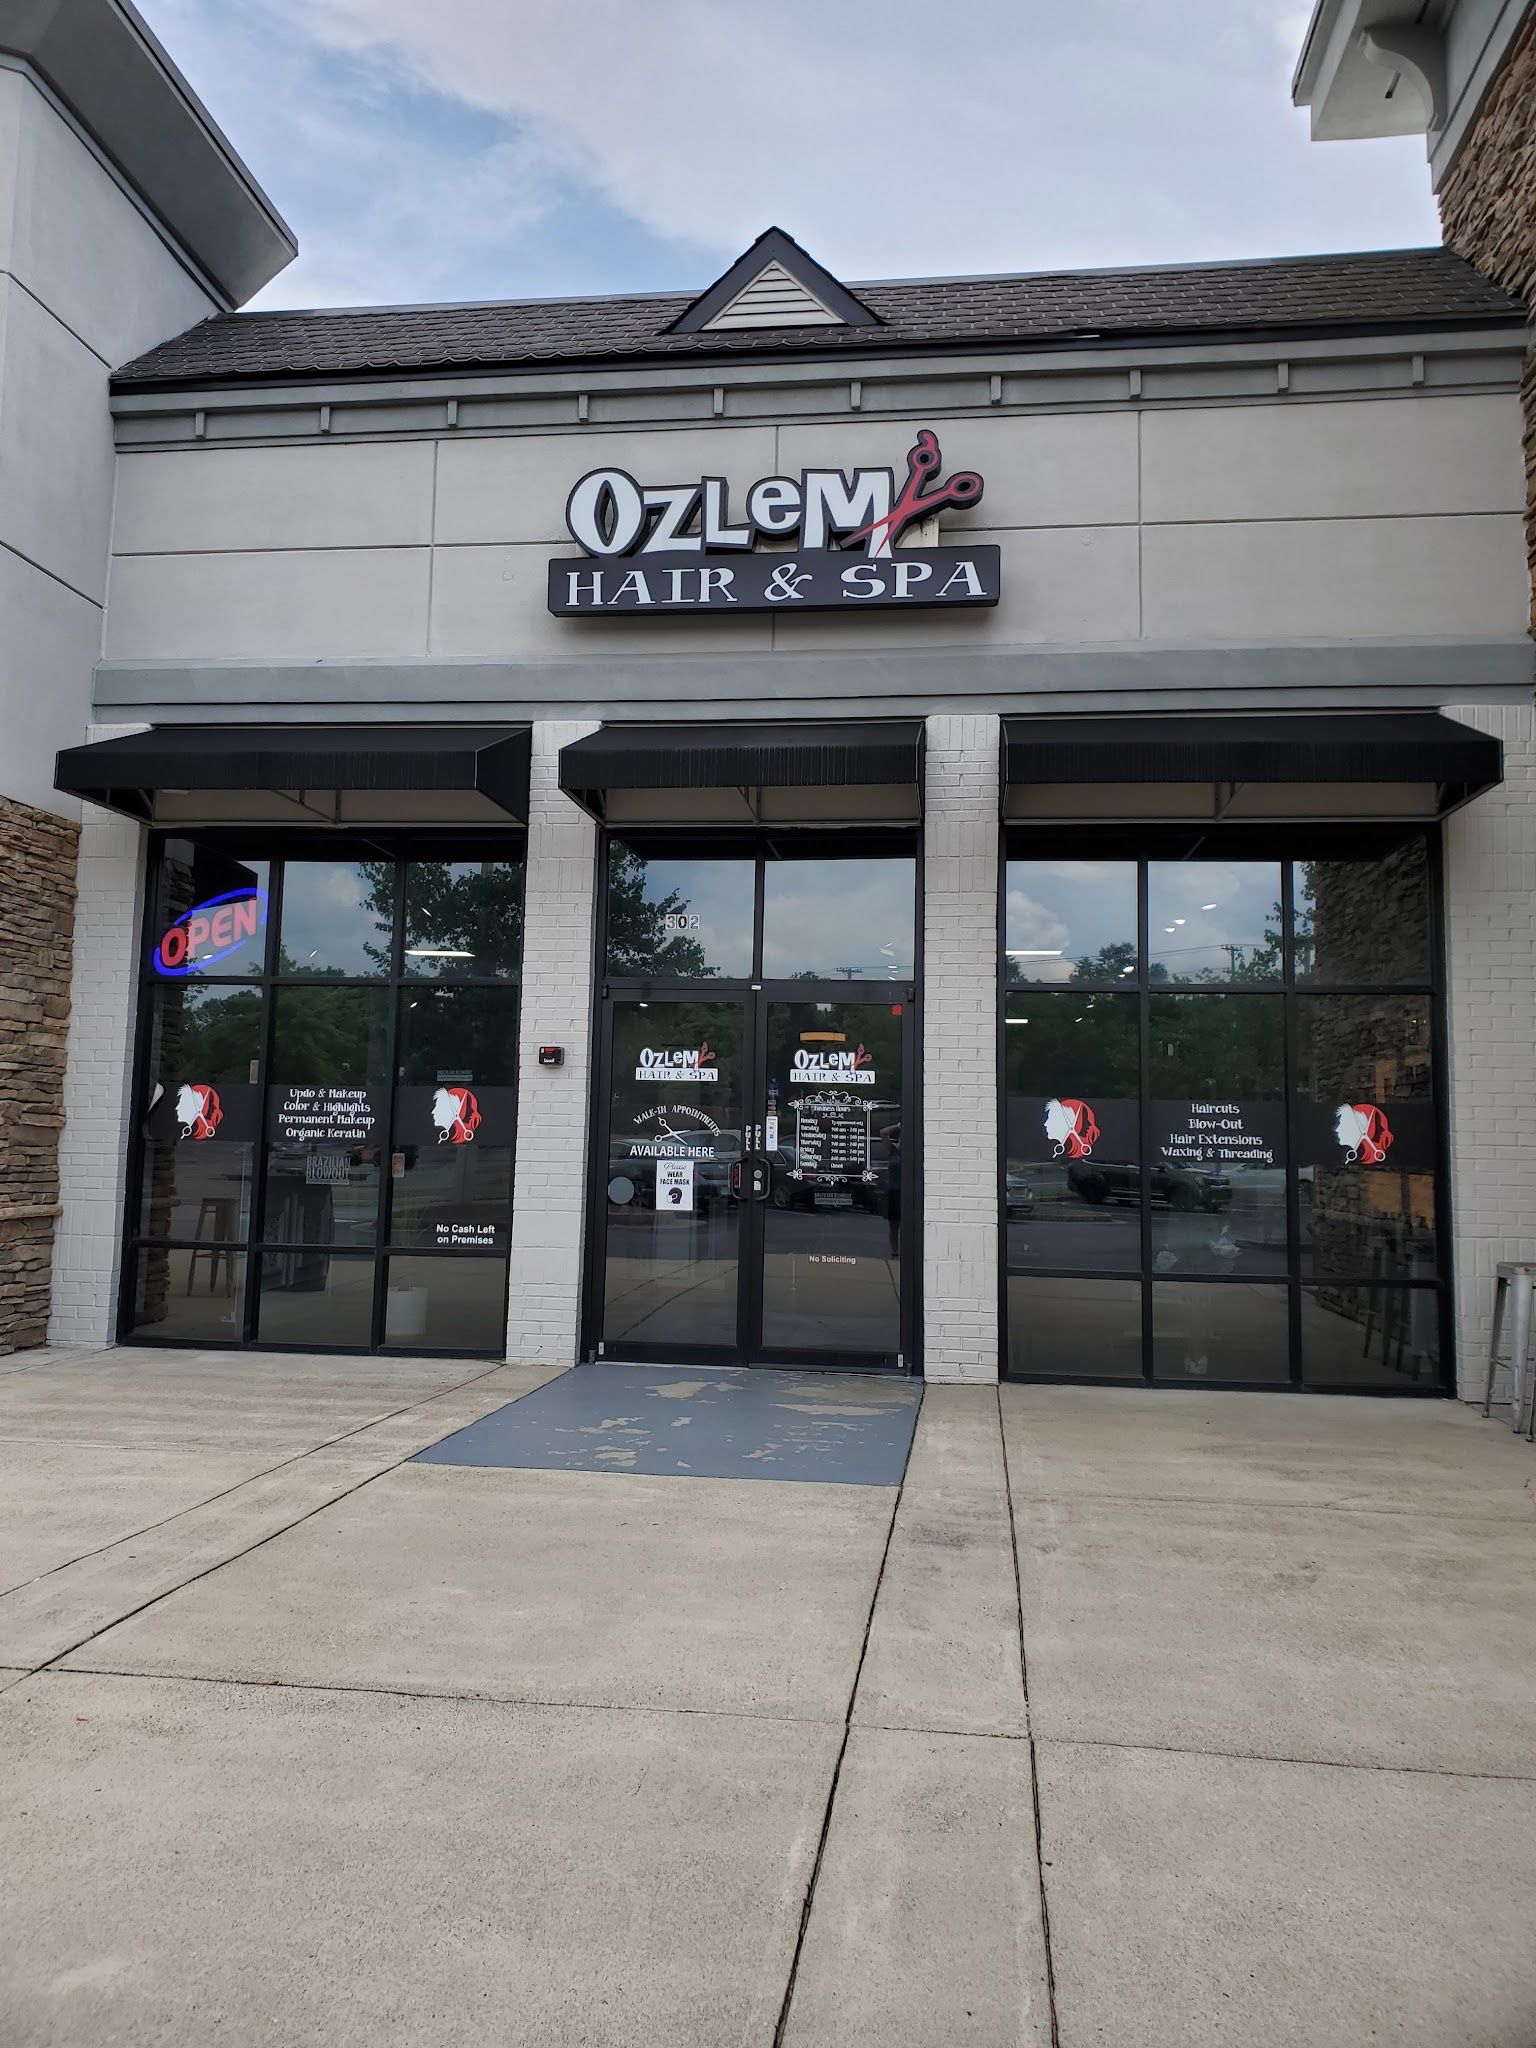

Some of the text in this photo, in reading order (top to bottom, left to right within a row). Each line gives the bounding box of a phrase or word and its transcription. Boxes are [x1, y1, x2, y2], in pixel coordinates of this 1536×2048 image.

[565, 561, 988, 606] HAIR & SPA
[666, 914, 700, 930] 302
[161, 897, 257, 967] OPEN
[639, 1070, 715, 1080] HAIR & SPA
[794, 1073, 872, 1083] HAIR & SPA
[290, 1088, 367, 1104] Updo & Makeup
[284, 1101, 371, 1116] Color & Highlights
[1191, 1103, 1241, 1114] Haircuts
[278, 1113, 375, 1130] Permanent Makeup
[633, 1104, 721, 1137] WALK-IN APPOINTMENTS
[1187, 1118, 1245, 1129] Blow-Out
[285, 1127, 366, 1141] Organic Keratin
[1169, 1133, 1263, 1145] Hair Extensions
[629, 1145, 715, 1157] AVAILABLE HERE
[1160, 1146, 1274, 1163] Waxing & Threading
[306, 1156, 351, 1168] BRAZILIAN
[663, 1161, 687, 1170] Please
[306, 1167, 350, 1180] BLOWOUT
[436, 1223, 496, 1235] No Cash Left
[437, 1235, 494, 1245] on Premises
[809, 1255, 856, 1265] No Soliciting
